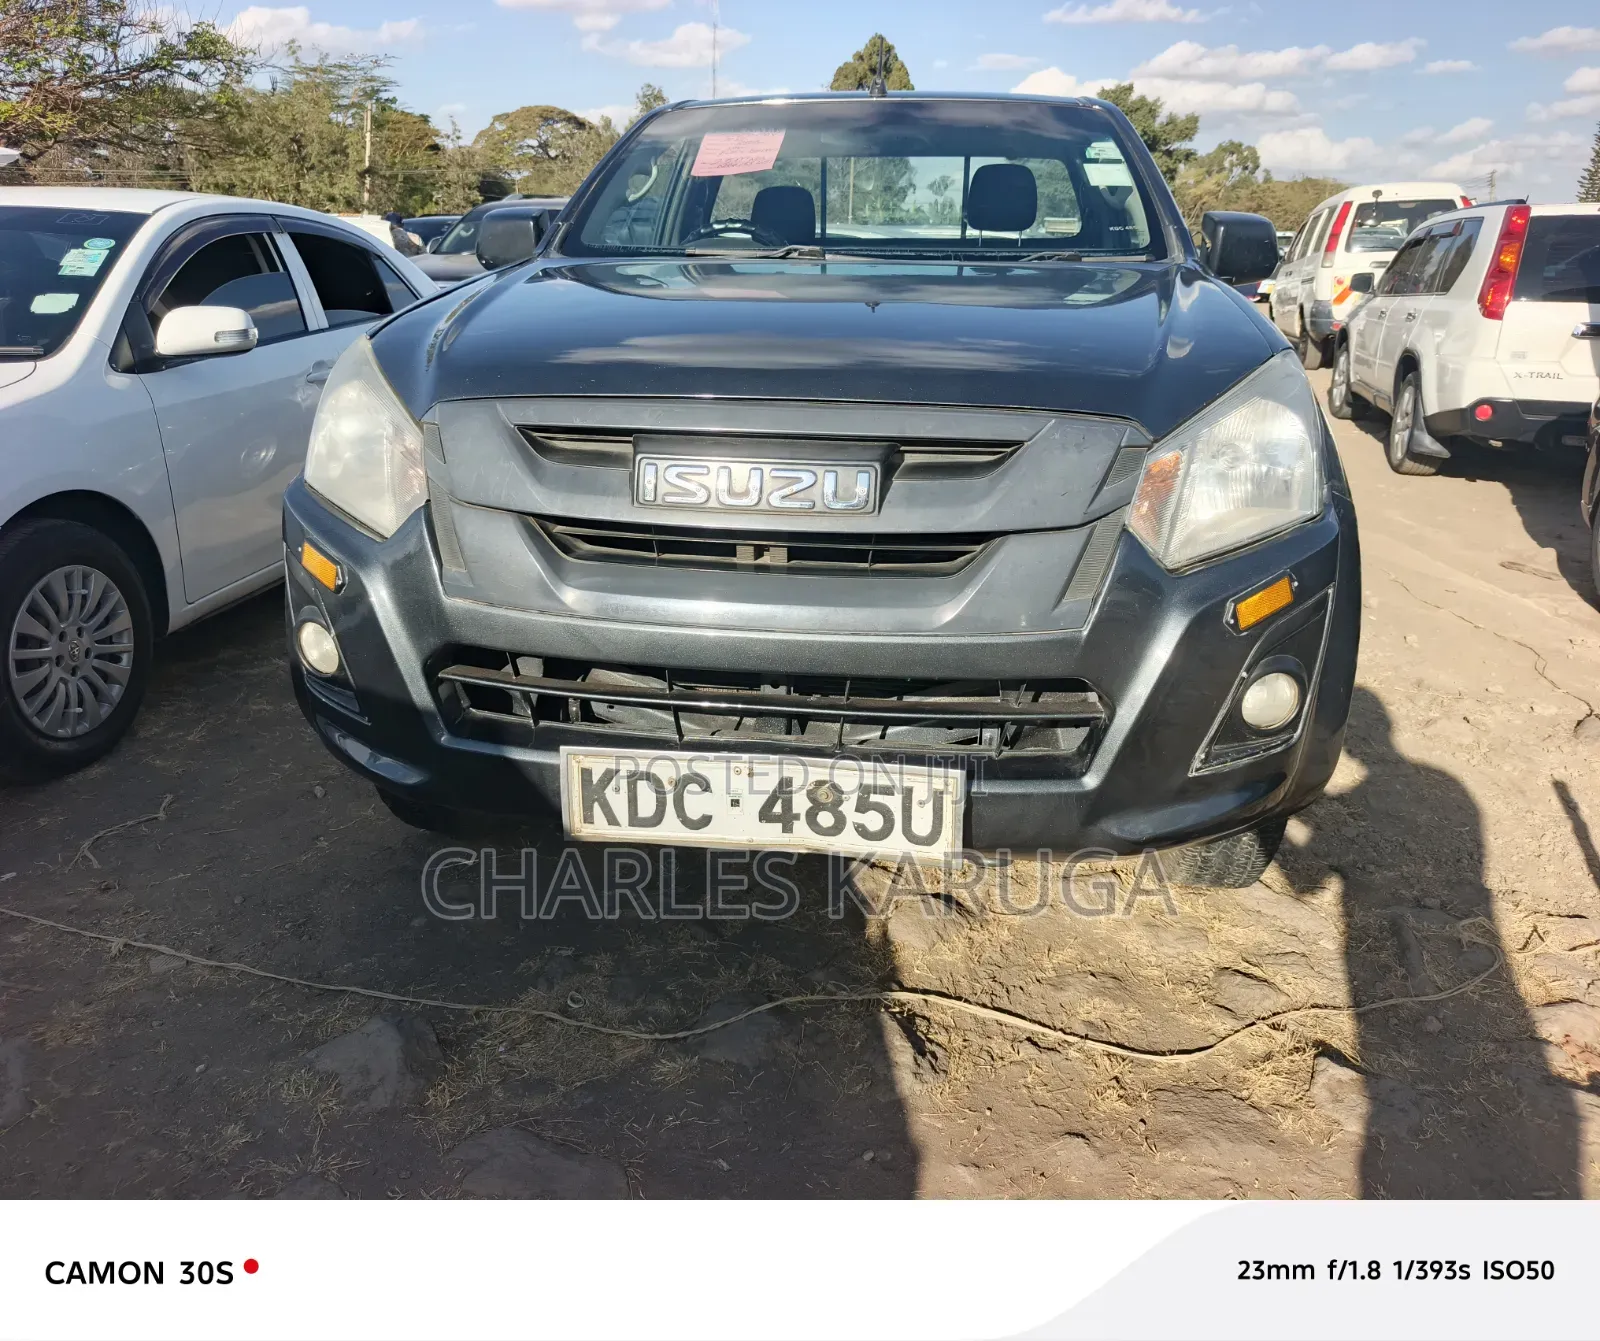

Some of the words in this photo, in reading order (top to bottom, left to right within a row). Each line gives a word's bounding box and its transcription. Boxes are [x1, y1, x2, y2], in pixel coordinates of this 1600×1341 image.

[1513, 371, 1563, 380] X-TRAIL
[643, 462, 871, 512] ISUZU
[580, 766, 714, 832] KDC
[757, 776, 944, 846] 485U
